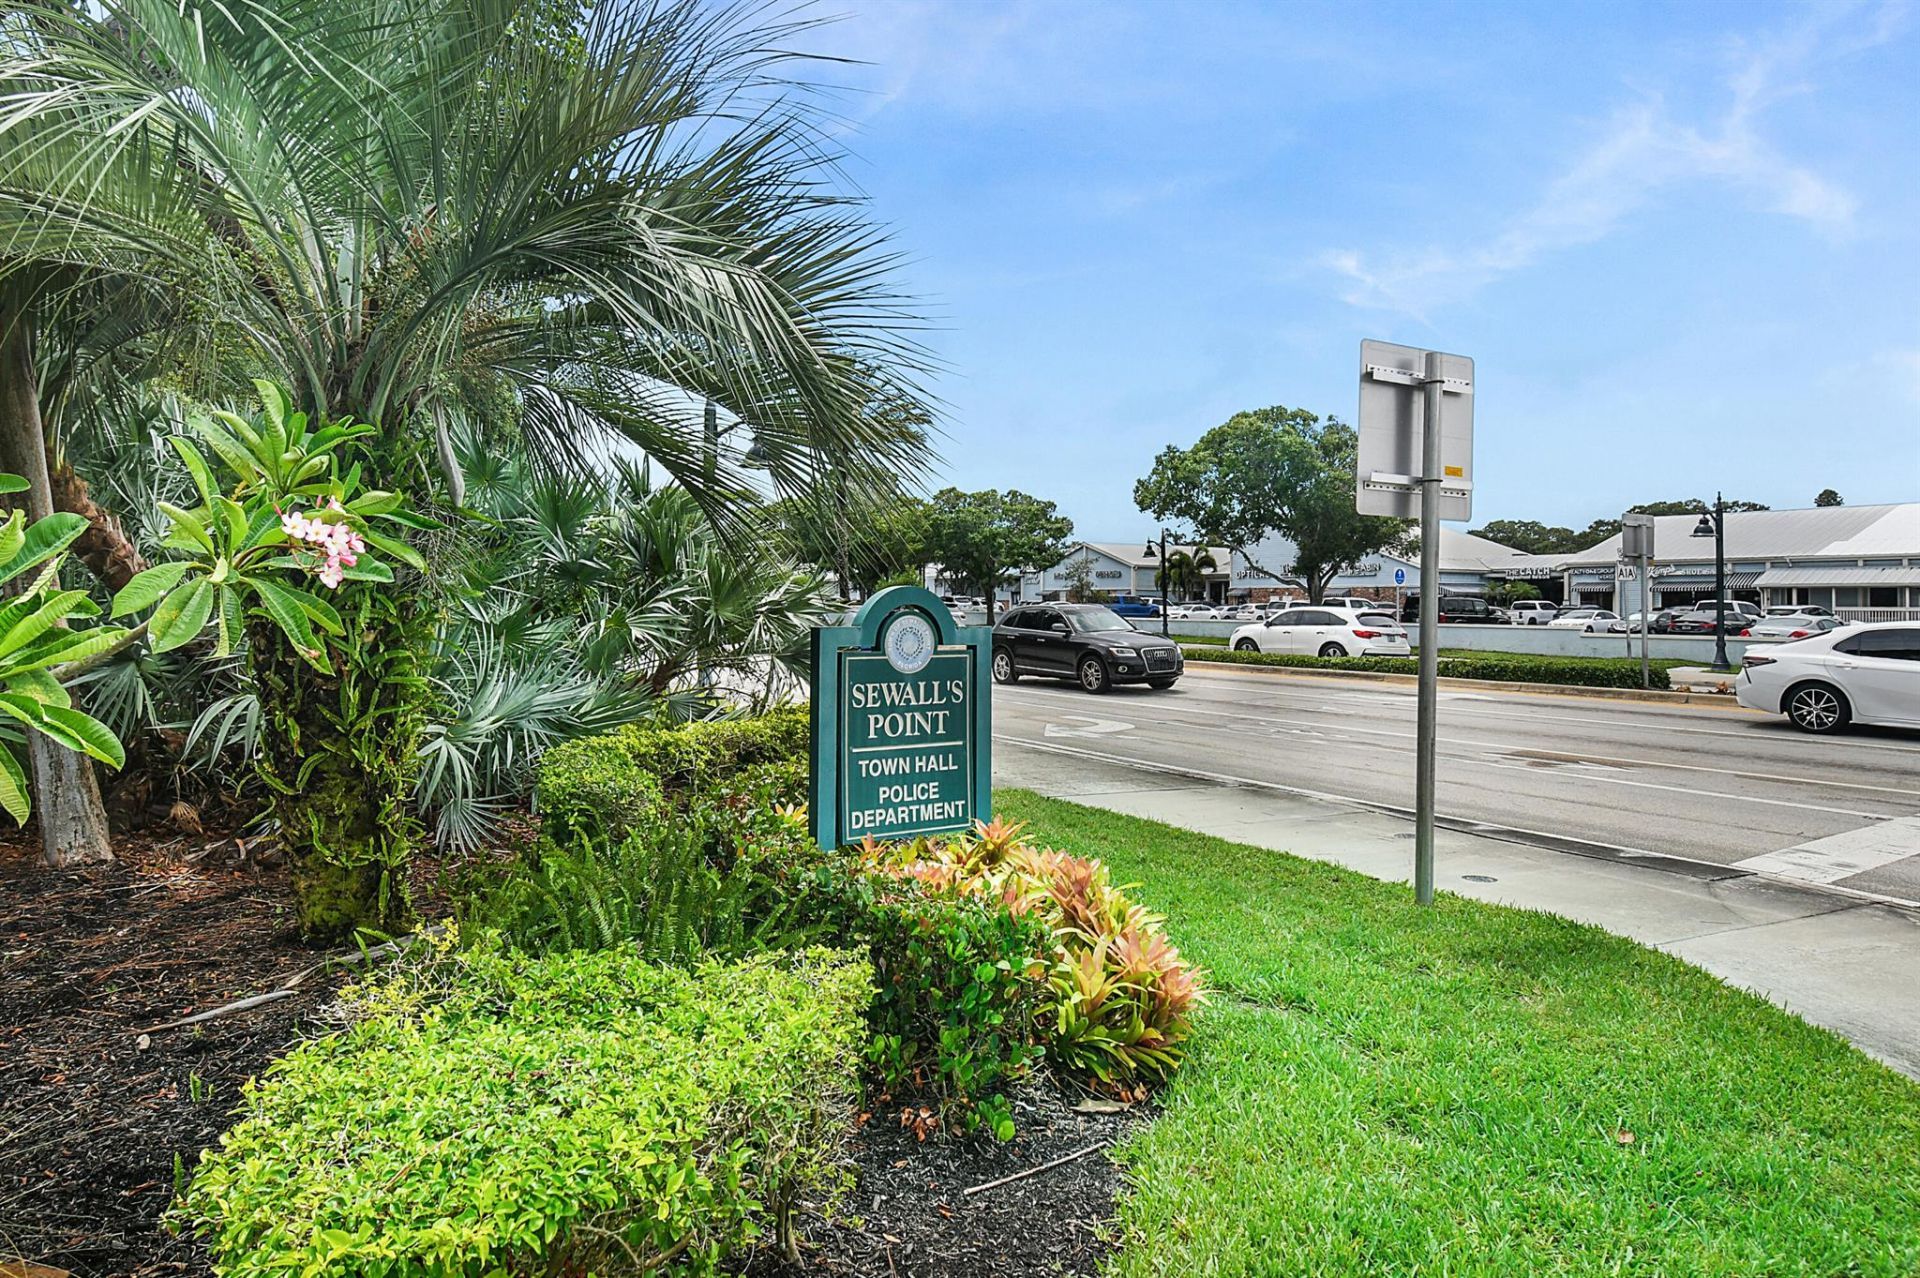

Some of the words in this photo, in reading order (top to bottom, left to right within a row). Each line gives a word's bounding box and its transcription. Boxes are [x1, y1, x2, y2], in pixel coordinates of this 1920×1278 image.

[1520, 567, 1550, 575] CATCH
[1618, 567, 1635, 578] A1A
[852, 680, 964, 708] SEWALL'S
[867, 711, 950, 739] POINT
[858, 757, 910, 777] TOWN
[915, 753, 958, 773] HALL
[879, 782, 939, 804] POLICE
[851, 800, 965, 829] DEPARTMENT
